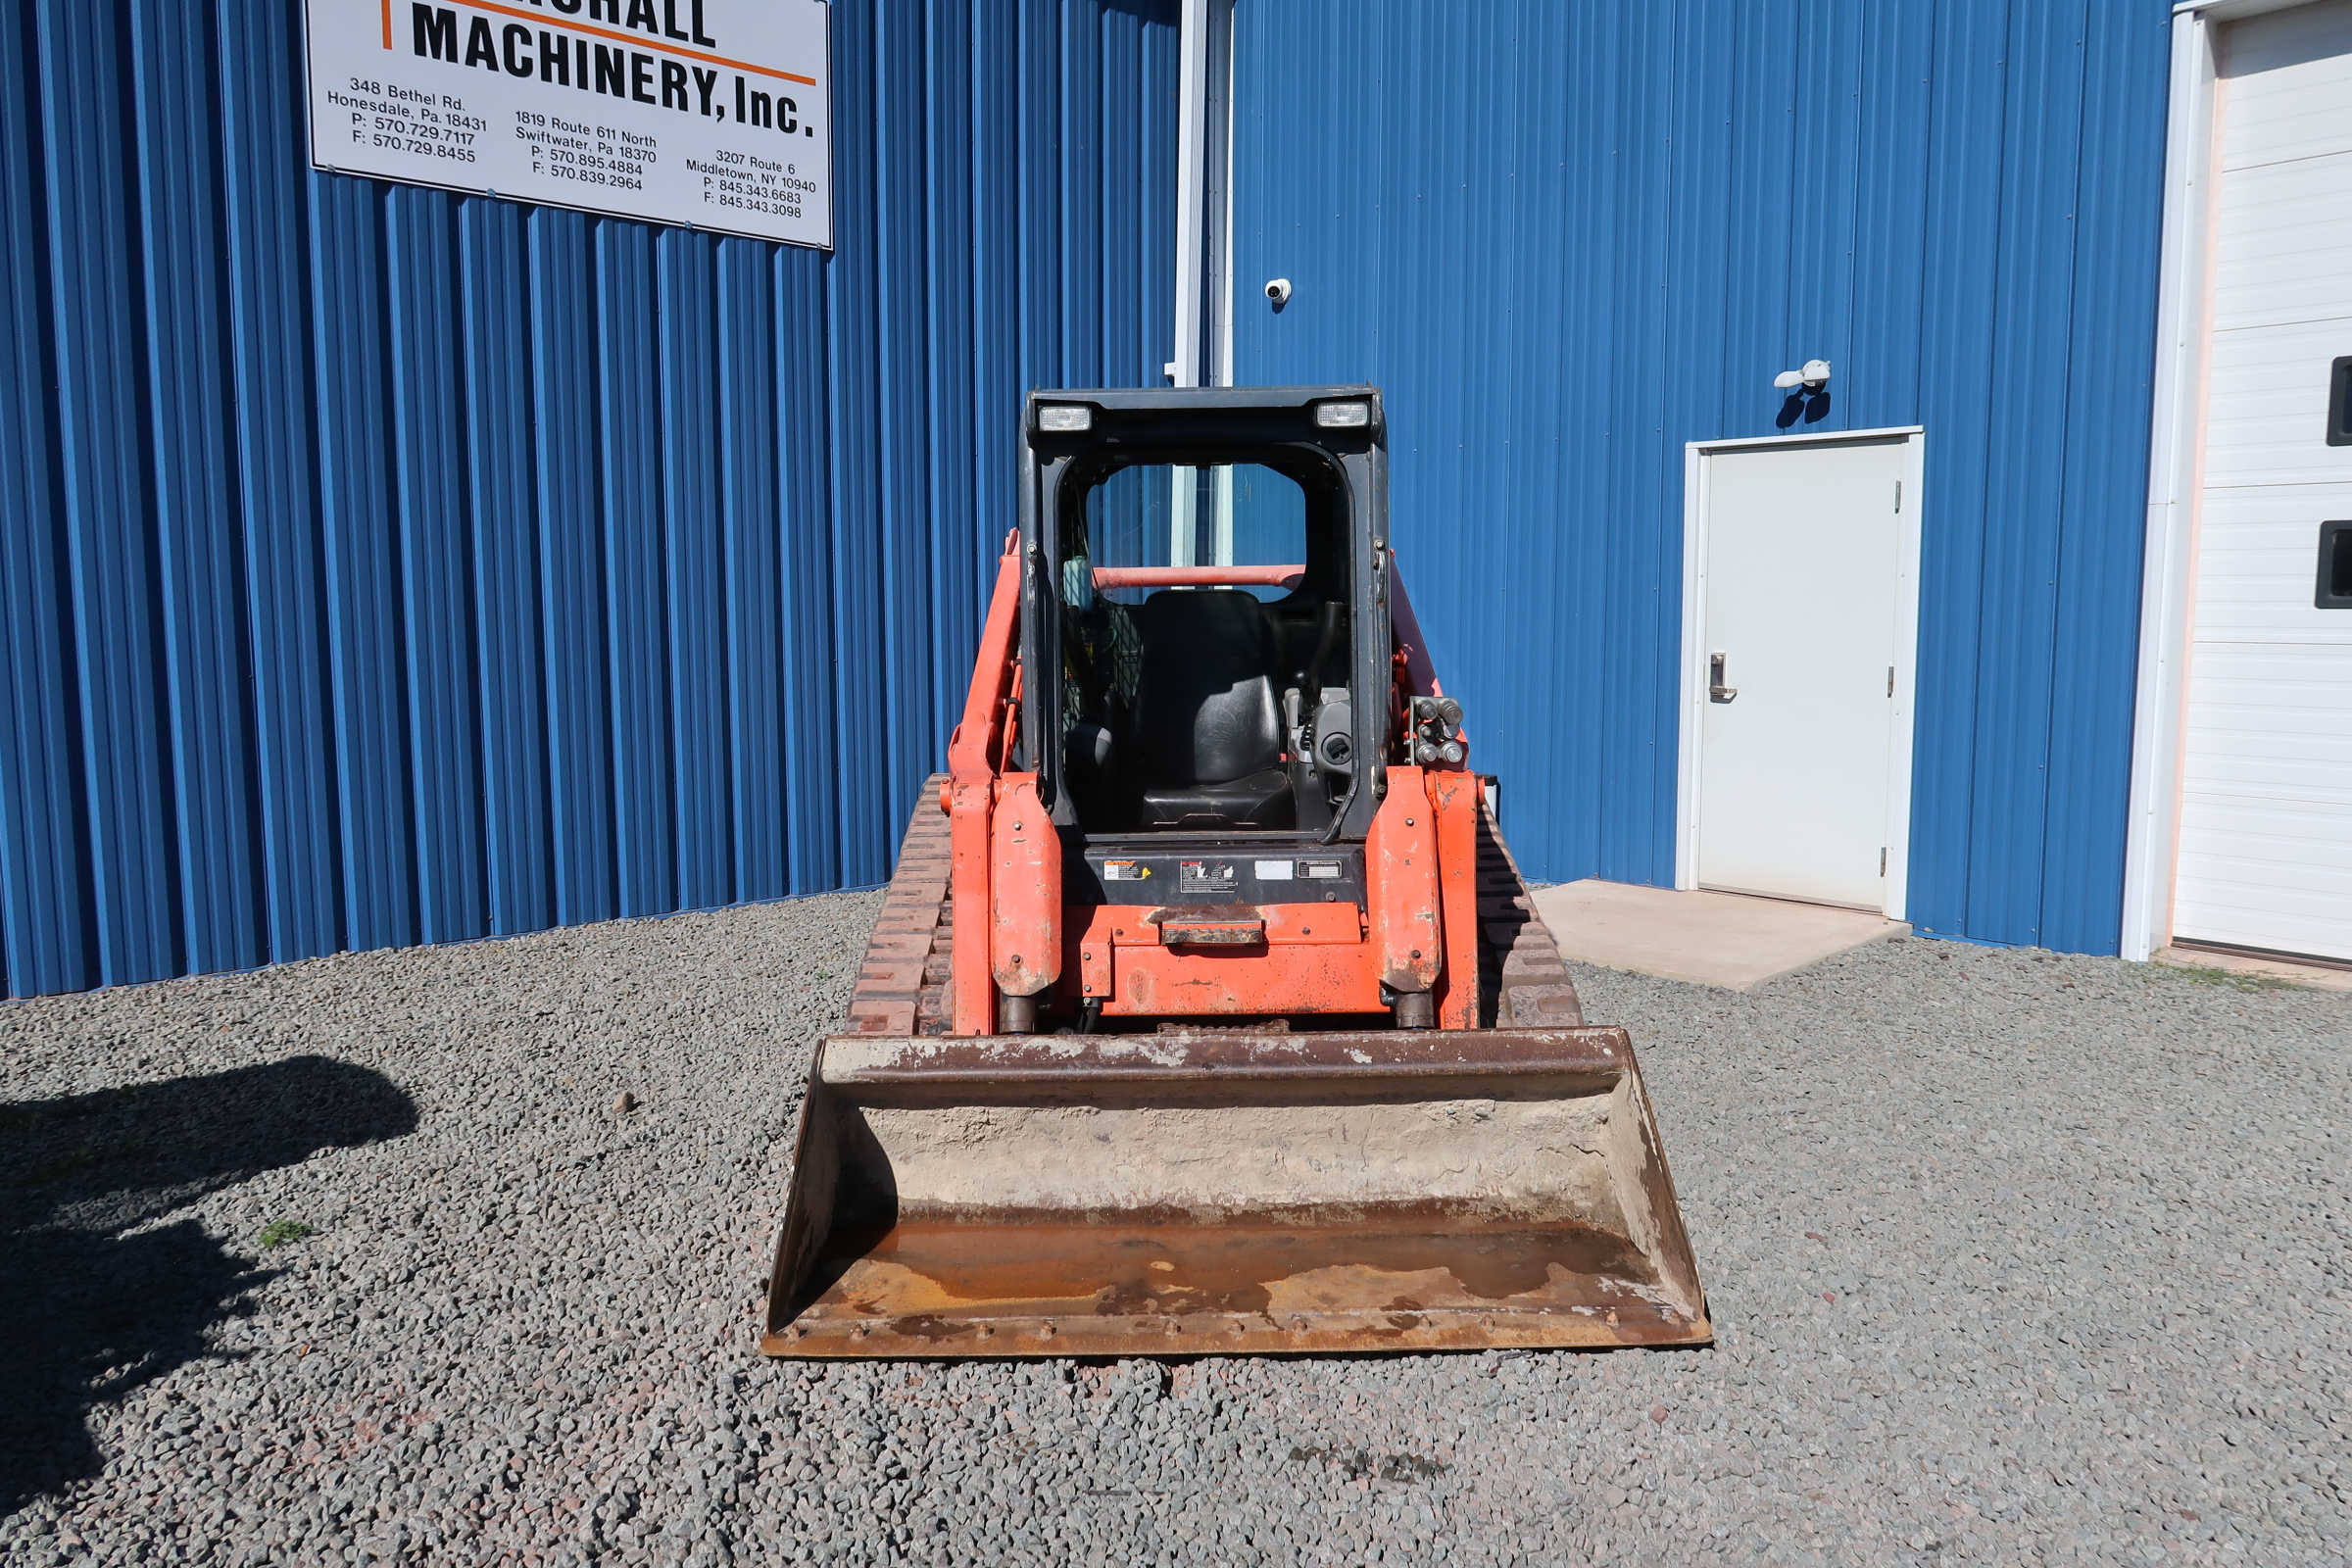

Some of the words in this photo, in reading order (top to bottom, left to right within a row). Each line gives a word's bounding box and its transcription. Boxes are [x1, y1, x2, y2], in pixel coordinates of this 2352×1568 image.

[327, 89, 416, 121] Honesdale,
[420, 107, 443, 124] Pa.
[445, 113, 487, 132] 18431
[349, 77, 381, 96] 348
[388, 84, 435, 107] Bethel
[441, 94, 466, 112] Rd.
[734, 74, 816, 138] Inc.
[352, 113, 367, 127] P:
[373, 116, 475, 146] 570.729.7117
[352, 129, 367, 144] F:
[372, 133, 476, 164] 570.729.8455
[514, 110, 547, 127] 1819
[551, 117, 591, 136] Route
[597, 125, 619, 140] 611
[621, 130, 659, 149] North
[514, 126, 592, 154] Swiftwater,
[598, 141, 613, 156] Pa
[618, 145, 657, 164] 18370
[531, 145, 545, 160] P:
[550, 148, 644, 176] 570.895.4884
[532, 161, 545, 175] F:
[550, 164, 644, 191] 570.839.2964
[686, 159, 756, 183] Middletown,
[761, 173, 777, 186] NY
[780, 176, 816, 193] 10940
[715, 149, 746, 165] 3207
[750, 155, 783, 172] Route
[787, 164, 796, 175] 6
[703, 176, 714, 189] P:
[719, 179, 802, 205] 845.343.6683
[703, 191, 714, 204] F:
[719, 193, 802, 219] 845.343.3098
